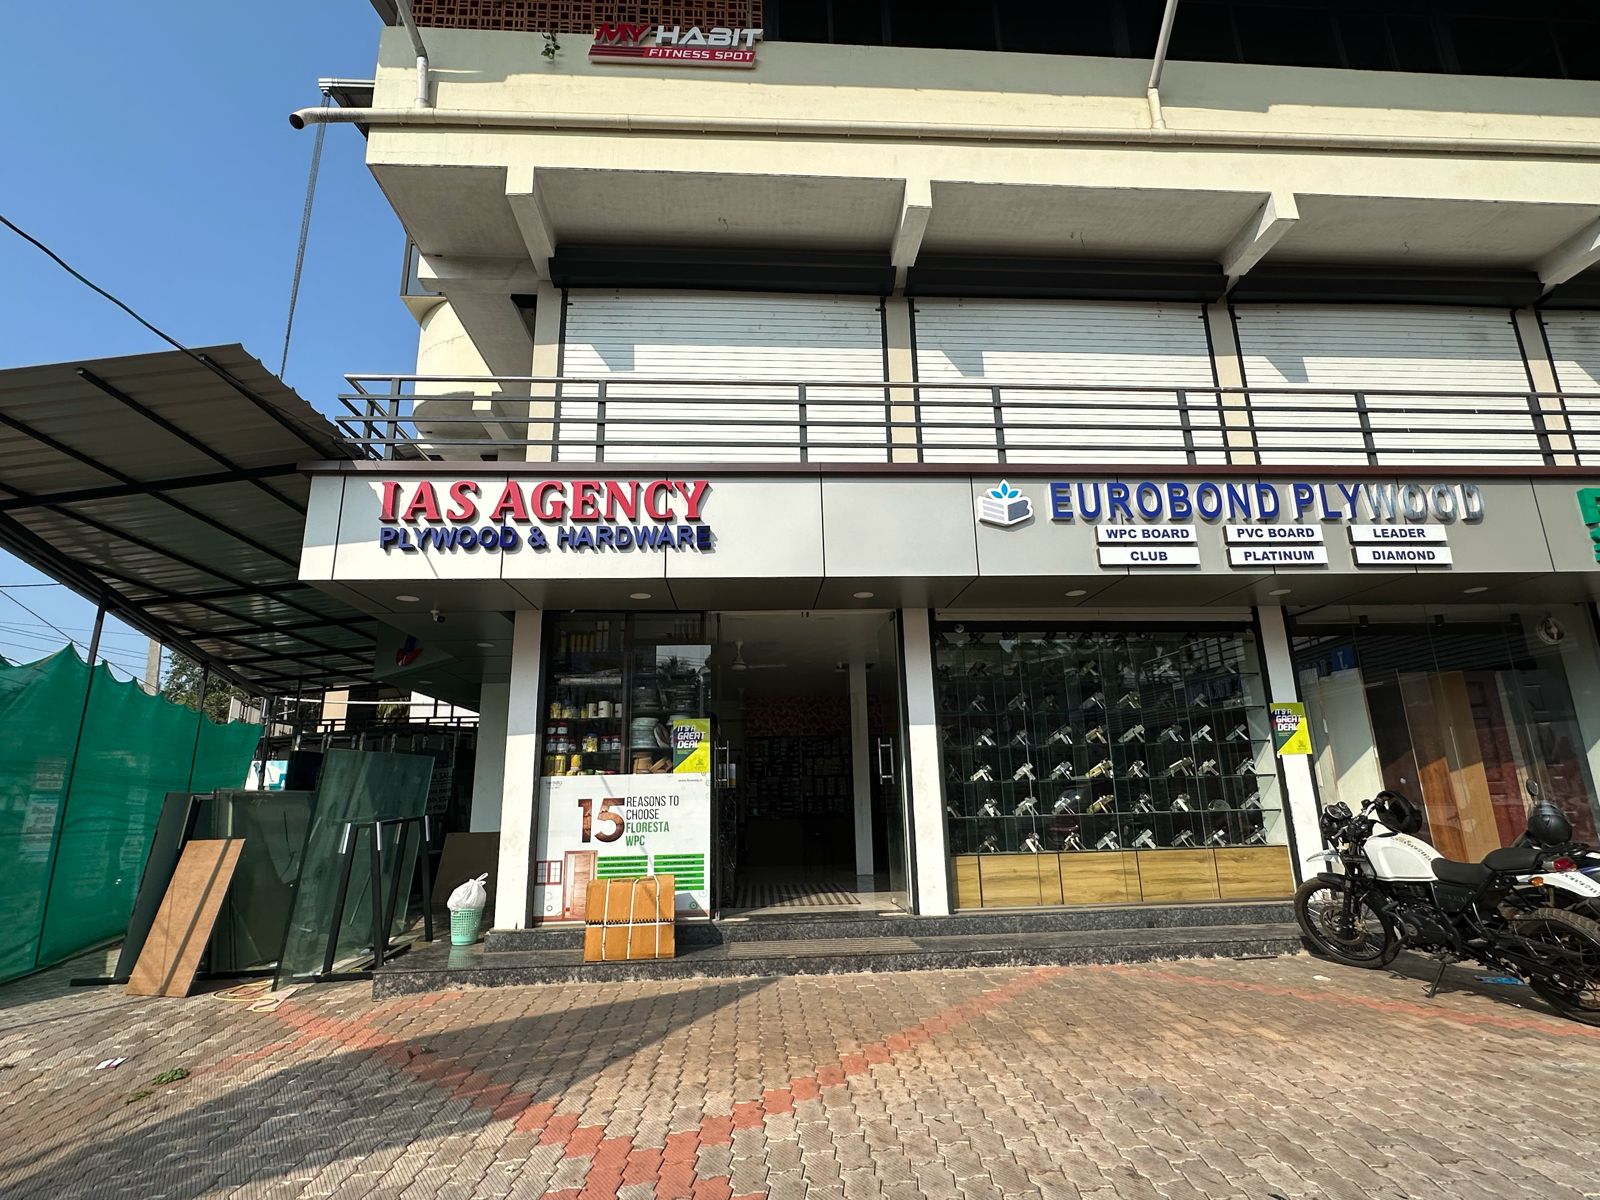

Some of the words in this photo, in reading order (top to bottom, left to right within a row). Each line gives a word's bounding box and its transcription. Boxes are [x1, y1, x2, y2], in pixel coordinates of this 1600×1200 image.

[594, 22, 652, 46] MY
[655, 25, 764, 49] HABIT
[648, 48, 710, 59] FITNESS
[714, 51, 753, 61] SPOT
[378, 480, 478, 523] IAS
[489, 480, 710, 523] AGENCY
[1048, 481, 1280, 521] EUROBOND
[1289, 482, 1485, 521] PLYWOOD
[379, 526, 518, 551] PLYWOOD
[527, 526, 548, 549] &
[556, 525, 713, 550] HARDWARE
[1105, 528, 1137, 539] WPC
[1141, 528, 1190, 539] BOARD
[1236, 527, 1264, 538] PVC
[1268, 527, 1315, 538] BOARD
[1372, 528, 1426, 538] LEADER
[1130, 551, 1168, 561] CLUB
[1244, 550, 1315, 561] PLATINUM
[1372, 550, 1436, 561] DIAMOND
[1275, 714, 1302, 723] GREAT
[1277, 722, 1298, 731] DEAL
[677, 731, 706, 740] GREAT
[677, 740, 699, 748] DEAL
[626, 796, 667, 807] REASONS
[668, 795, 680, 806] TO
[626, 808, 660, 820] CHOOSE
[577, 797, 626, 843] 15
[626, 821, 670, 833] FLORESTA
[625, 835, 646, 847] WPC
